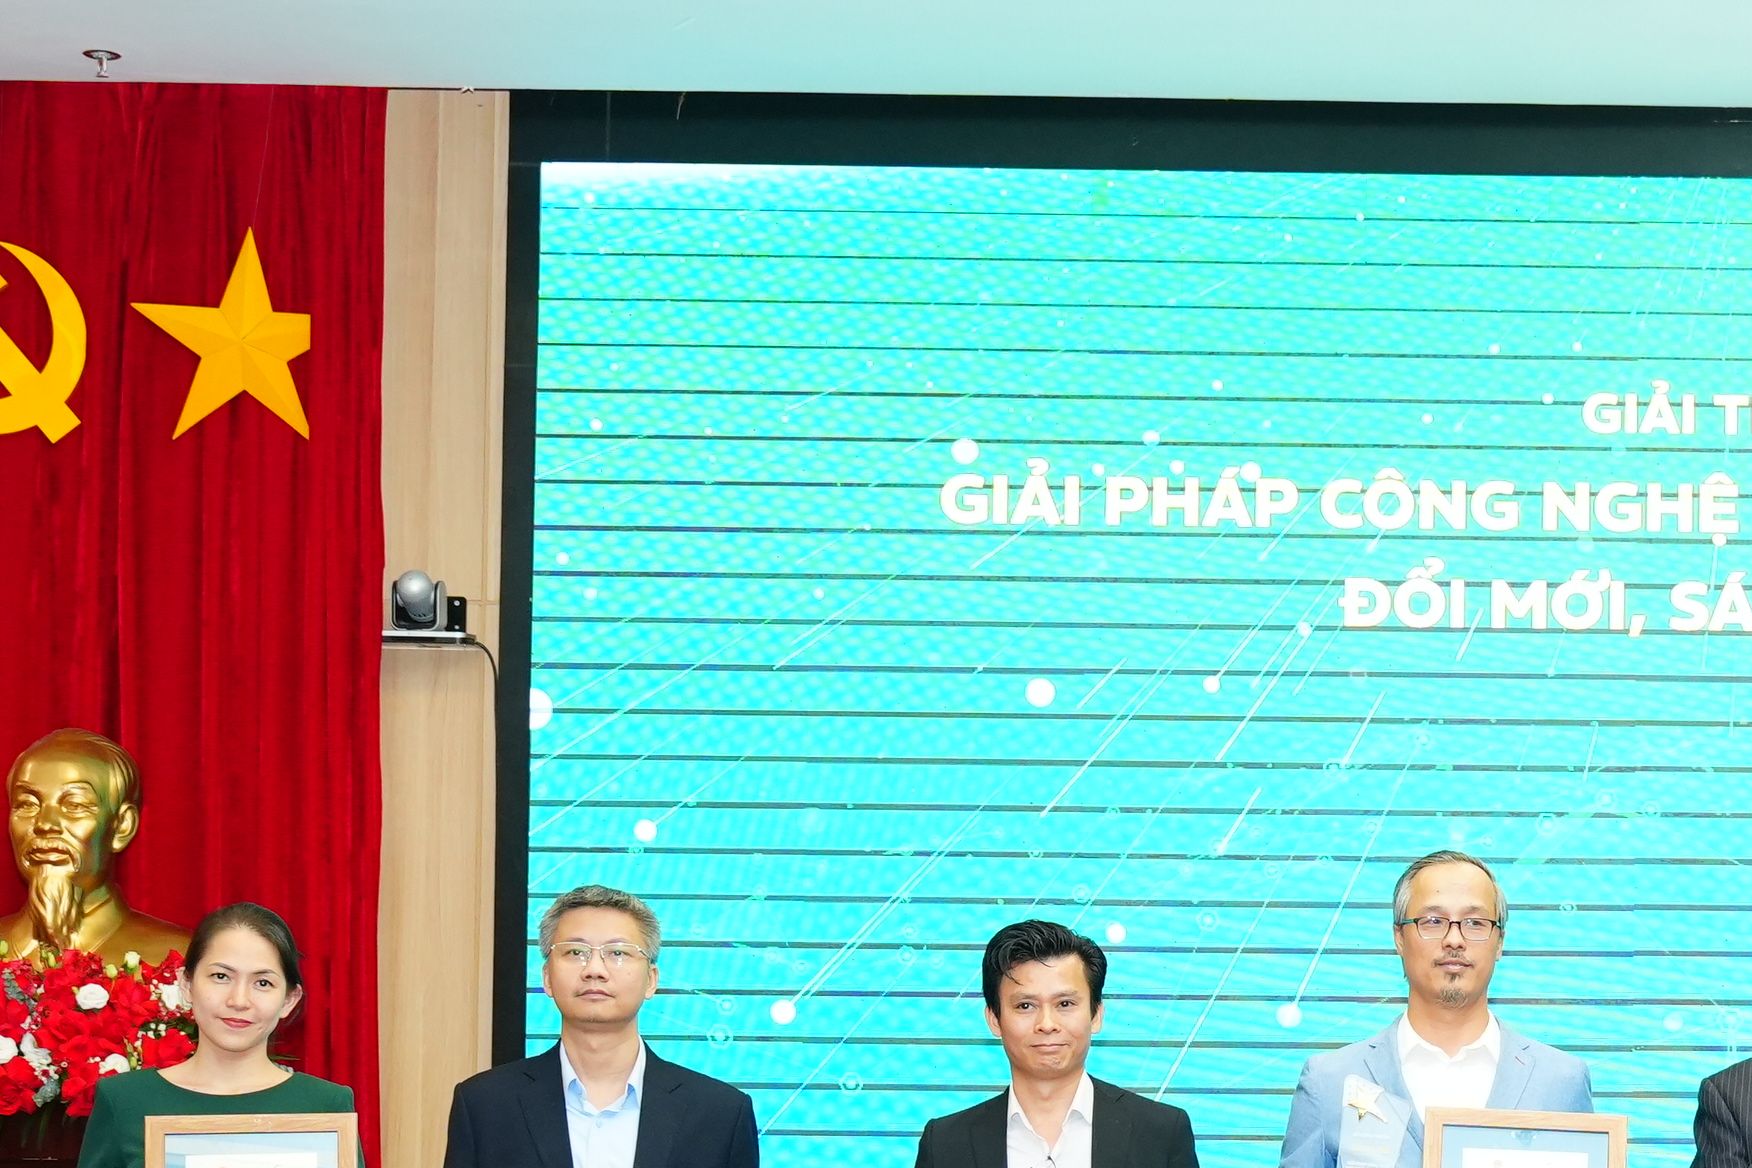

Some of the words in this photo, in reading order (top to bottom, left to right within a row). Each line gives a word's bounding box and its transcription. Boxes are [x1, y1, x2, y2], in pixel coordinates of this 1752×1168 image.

[1582, 379, 1696, 435] GIẢI
[940, 457, 1083, 527] GIẢI
[1105, 461, 1299, 528] PHÁP
[1320, 467, 1521, 531] CÔNG
[1542, 472, 1740, 549] NGHỆ
[1338, 556, 1466, 629] ĐỔI
[1490, 568, 1646, 638] MỚI,
